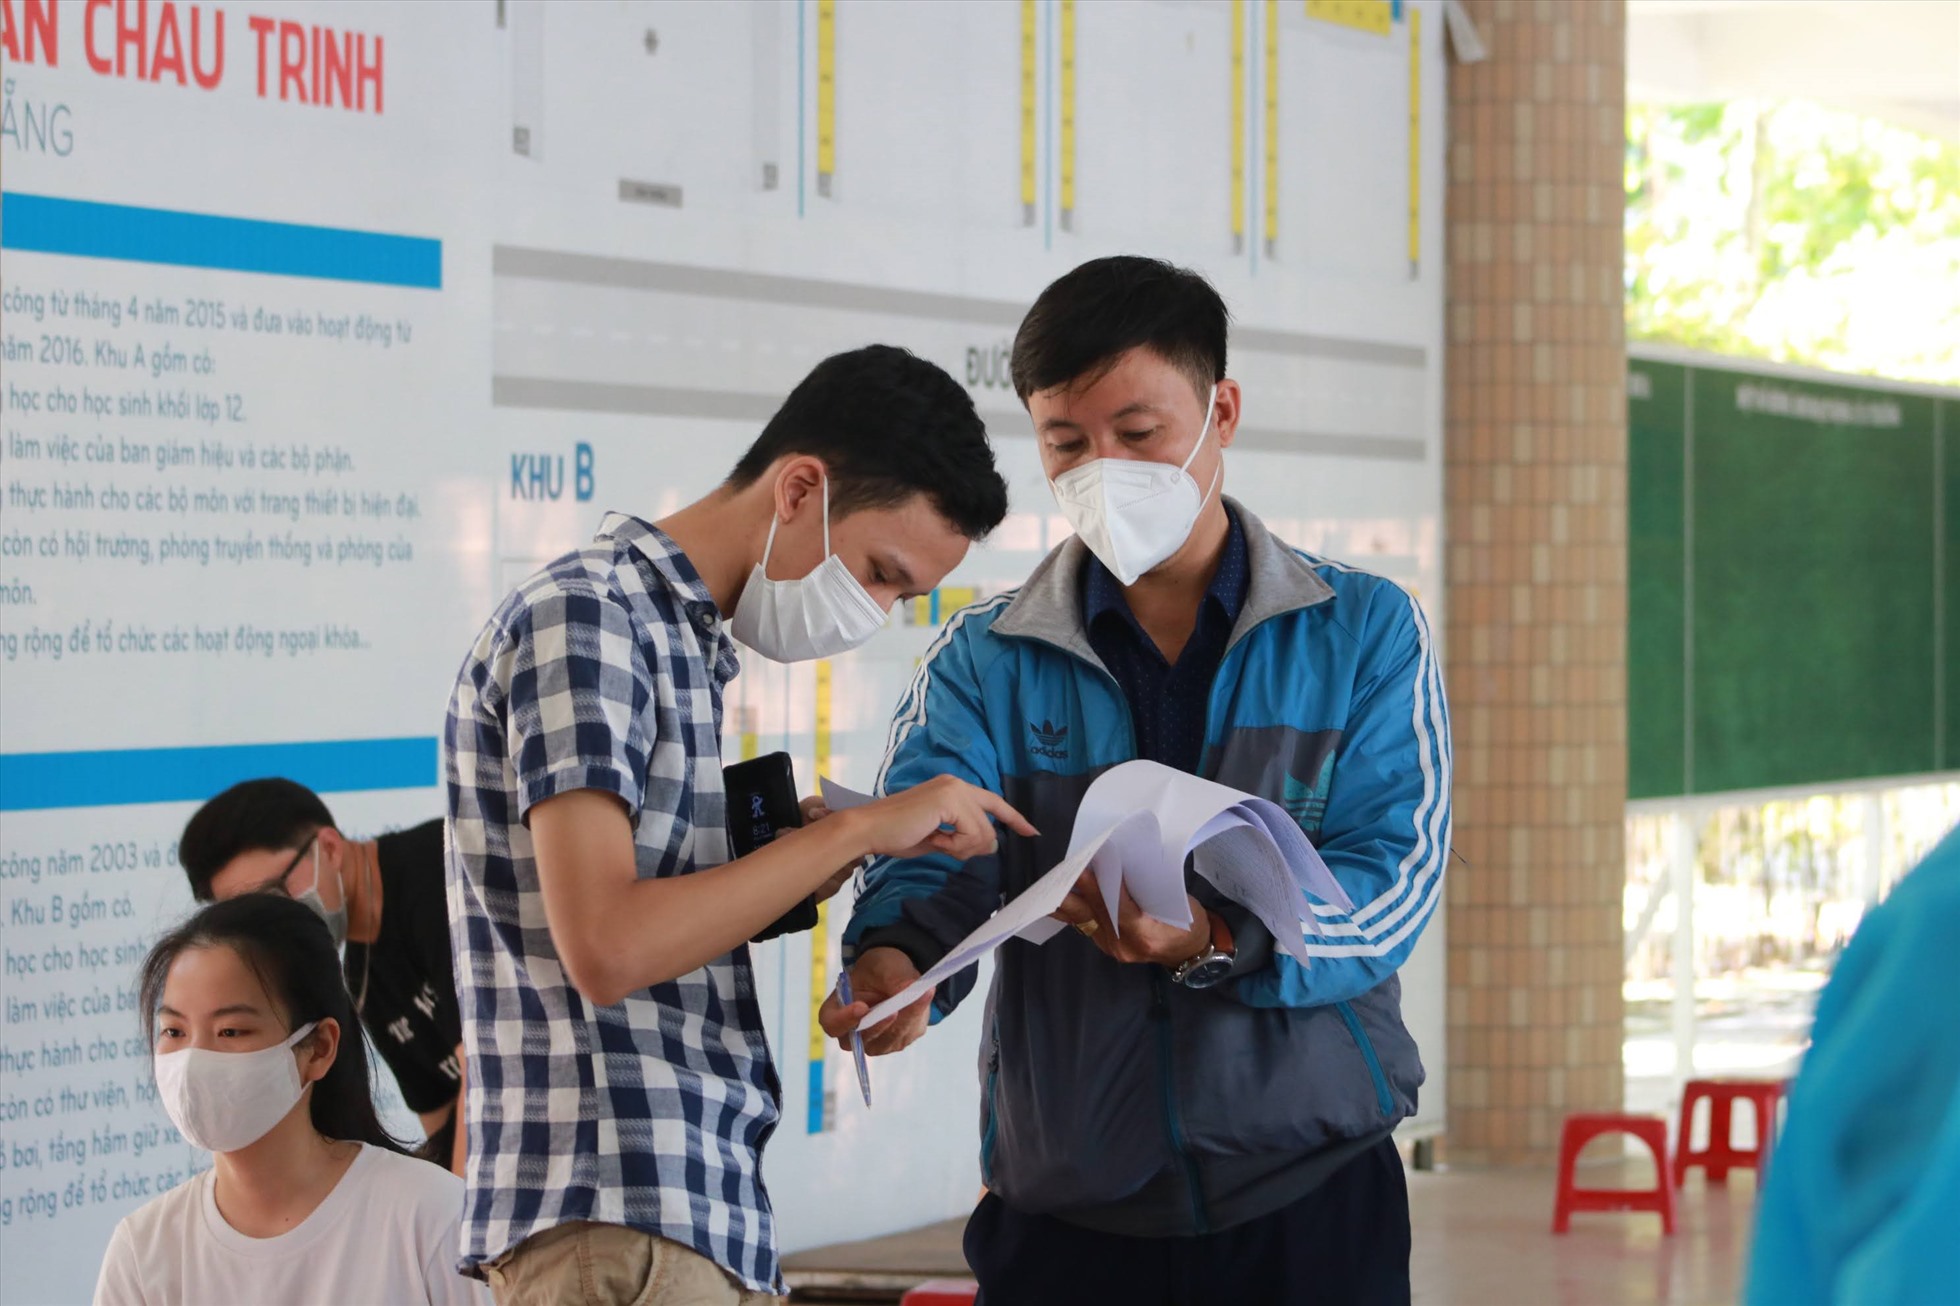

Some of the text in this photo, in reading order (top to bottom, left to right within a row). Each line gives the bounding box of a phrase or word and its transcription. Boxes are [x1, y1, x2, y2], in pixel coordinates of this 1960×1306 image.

[249, 15, 384, 115] TRINH
[4, 286, 45, 322] công
[74, 290, 121, 328] tháng
[128, 295, 138, 321] 4
[145, 298, 180, 325] năm
[185, 298, 226, 329] 2015
[231, 304, 248, 332] và
[253, 306, 283, 334] đưa
[287, 309, 313, 336] vào
[317, 312, 350, 343] hoạt
[355, 314, 392, 349] động
[40, 335, 89, 366] 2016.
[95, 338, 128, 368] Khu
[134, 343, 146, 369] A
[10, 382, 40, 417] học
[47, 386, 77, 414] cho
[83, 387, 113, 421] học
[119, 391, 151, 417] sinh
[157, 387, 190, 419] khối
[196, 391, 220, 427] lớp
[225, 393, 247, 422] 12.
[9, 431, 41, 460] làm
[47, 432, 80, 466] việc
[85, 434, 115, 463] của
[120, 436, 150, 464] ban
[156, 438, 196, 472] giám
[201, 440, 233, 474] hiệu
[239, 442, 256, 469] và
[261, 444, 286, 471] các
[291, 443, 310, 476] bộ
[511, 441, 595, 502] KHU B
[9, 480, 46, 514] thực
[53, 481, 95, 510] hành
[100, 483, 130, 511] cho
[135, 485, 162, 512] các
[168, 485, 188, 517] bộ
[194, 486, 228, 514] môn
[234, 487, 255, 514] với
[260, 489, 300, 523] trang
[305, 487, 338, 516] thiết
[361, 490, 391, 521] hiện
[2, 529, 414, 568] còn có hội trường, phòng truyền thống và phòng của
[24, 626, 63, 661] rộng
[69, 618, 91, 654] để
[97, 618, 113, 654] tổ
[118, 624, 157, 654] chức
[163, 624, 190, 653] các
[195, 624, 229, 658] hoạt
[235, 623, 274, 659] động
[279, 624, 320, 658] ngoại
[1030, 746, 1069, 759] adidas
[47, 847, 84, 876] năm
[90, 842, 138, 873] 2003
[144, 841, 160, 869] và
[12, 897, 45, 928] Khu
[52, 894, 63, 923] B
[6, 947, 36, 982] học
[43, 943, 74, 973] cho
[80, 940, 107, 975] học
[7, 984, 140, 1025] làm việc của ba
[41, 1037, 82, 1069] hành
[89, 1033, 118, 1062] cho
[35, 1088, 54, 1118] có
[61, 1085, 88, 1115] thư
[92, 1080, 130, 1112] viện,
[13, 1141, 42, 1172] bơi,
[49, 1130, 86, 1167] tầng
[92, 1123, 128, 1156] hầm
[134, 1122, 159, 1158] giữ
[19, 1187, 57, 1221] rộng
[64, 1172, 84, 1208] để
[91, 1168, 107, 1205] tổ
[113, 1168, 150, 1199] chức
